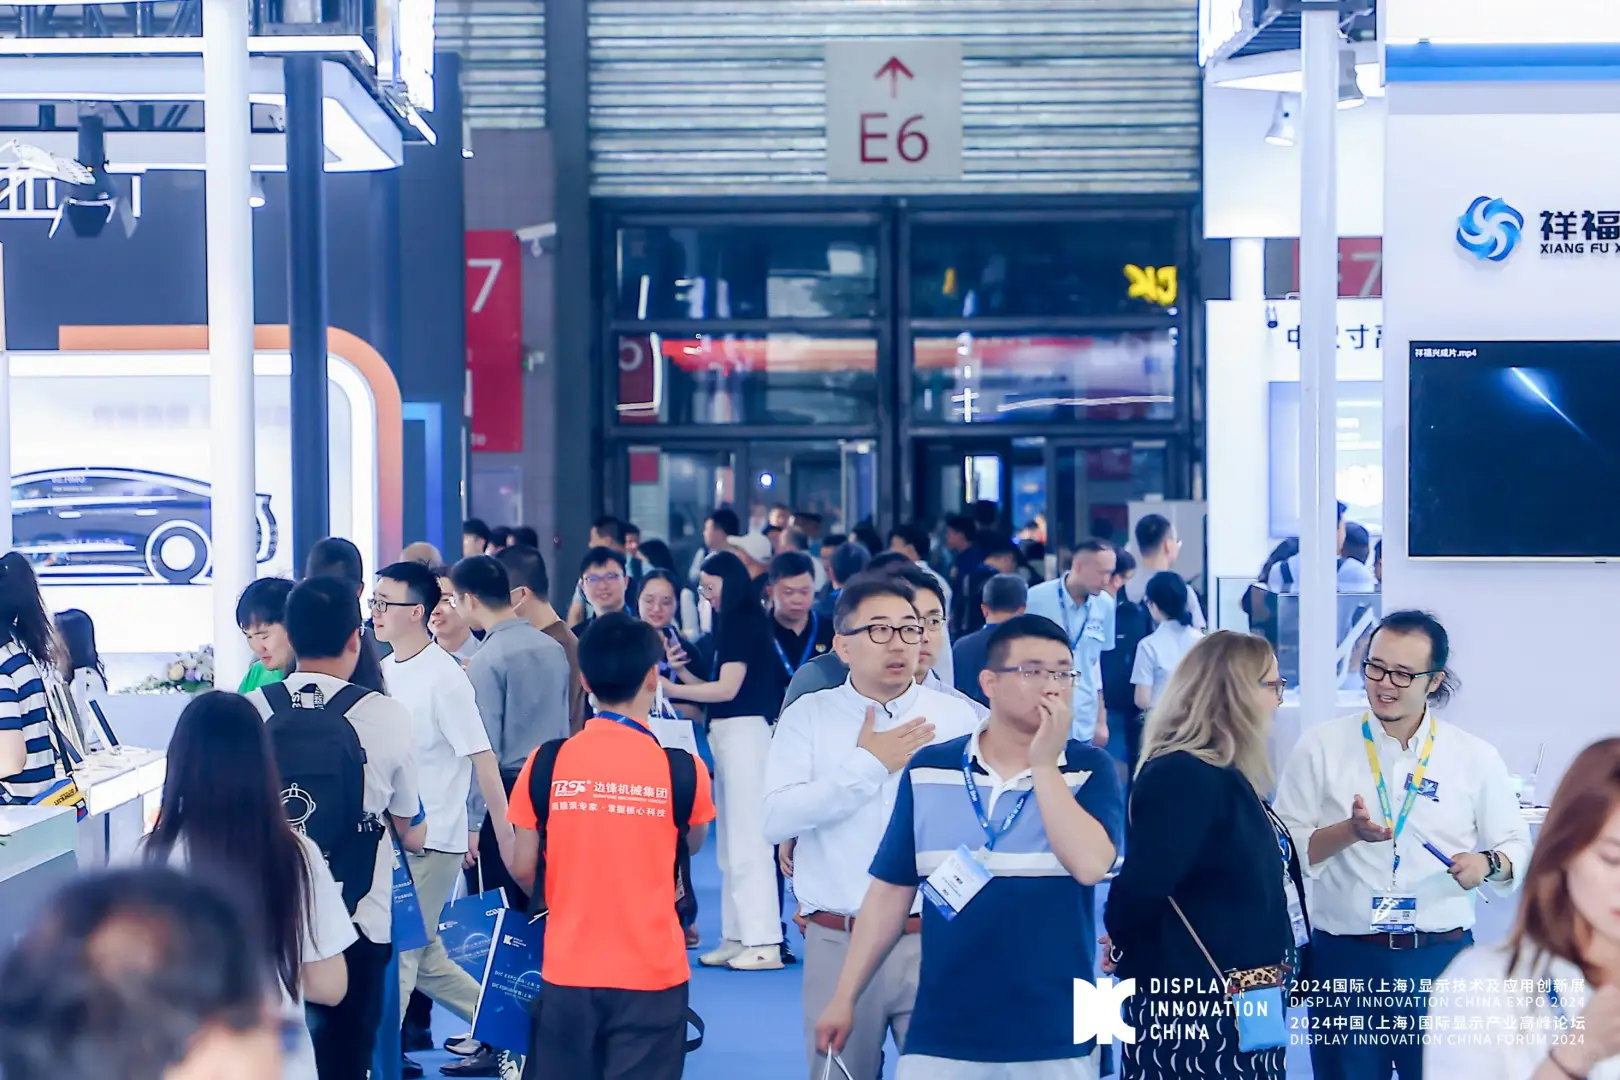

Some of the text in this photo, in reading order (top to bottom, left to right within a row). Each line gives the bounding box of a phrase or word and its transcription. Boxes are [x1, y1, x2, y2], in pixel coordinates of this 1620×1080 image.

[860, 112, 929, 164] E6
[1539, 210, 1620, 241] 祥福
[1540, 243, 1584, 254] XIANG
[1590, 243, 1609, 254] FU
[594, 781, 668, 798] 边锋机械集团
